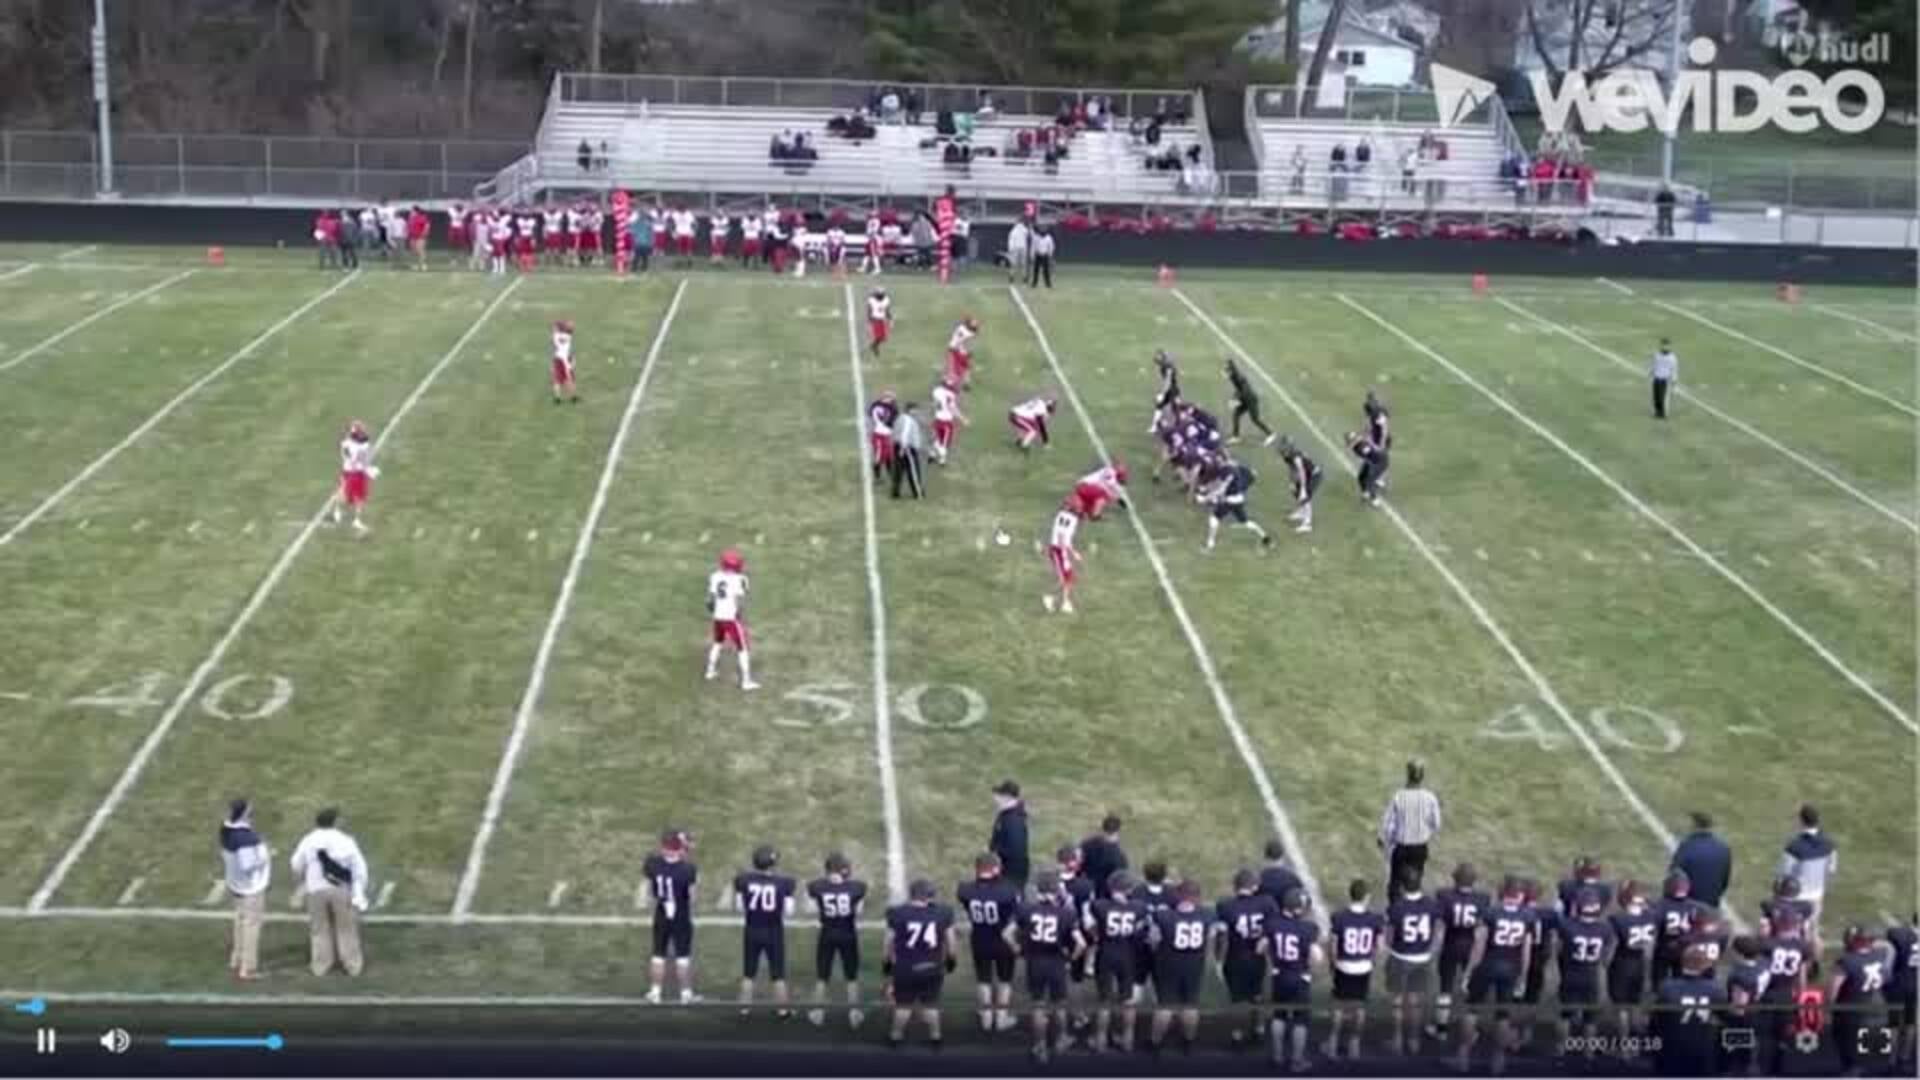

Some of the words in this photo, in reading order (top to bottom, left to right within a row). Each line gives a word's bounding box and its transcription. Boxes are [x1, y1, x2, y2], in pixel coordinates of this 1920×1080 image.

[774, 682, 987, 728] 50
[1475, 702, 1685, 752] 40
[748, 884, 776, 912] 70
[906, 921, 937, 949] 74
[1030, 914, 1058, 943] 32
[1403, 914, 1431, 943] 54
[1494, 919, 1526, 946] 22
[1572, 936, 1603, 963] 33
[1769, 947, 1801, 977] 83
